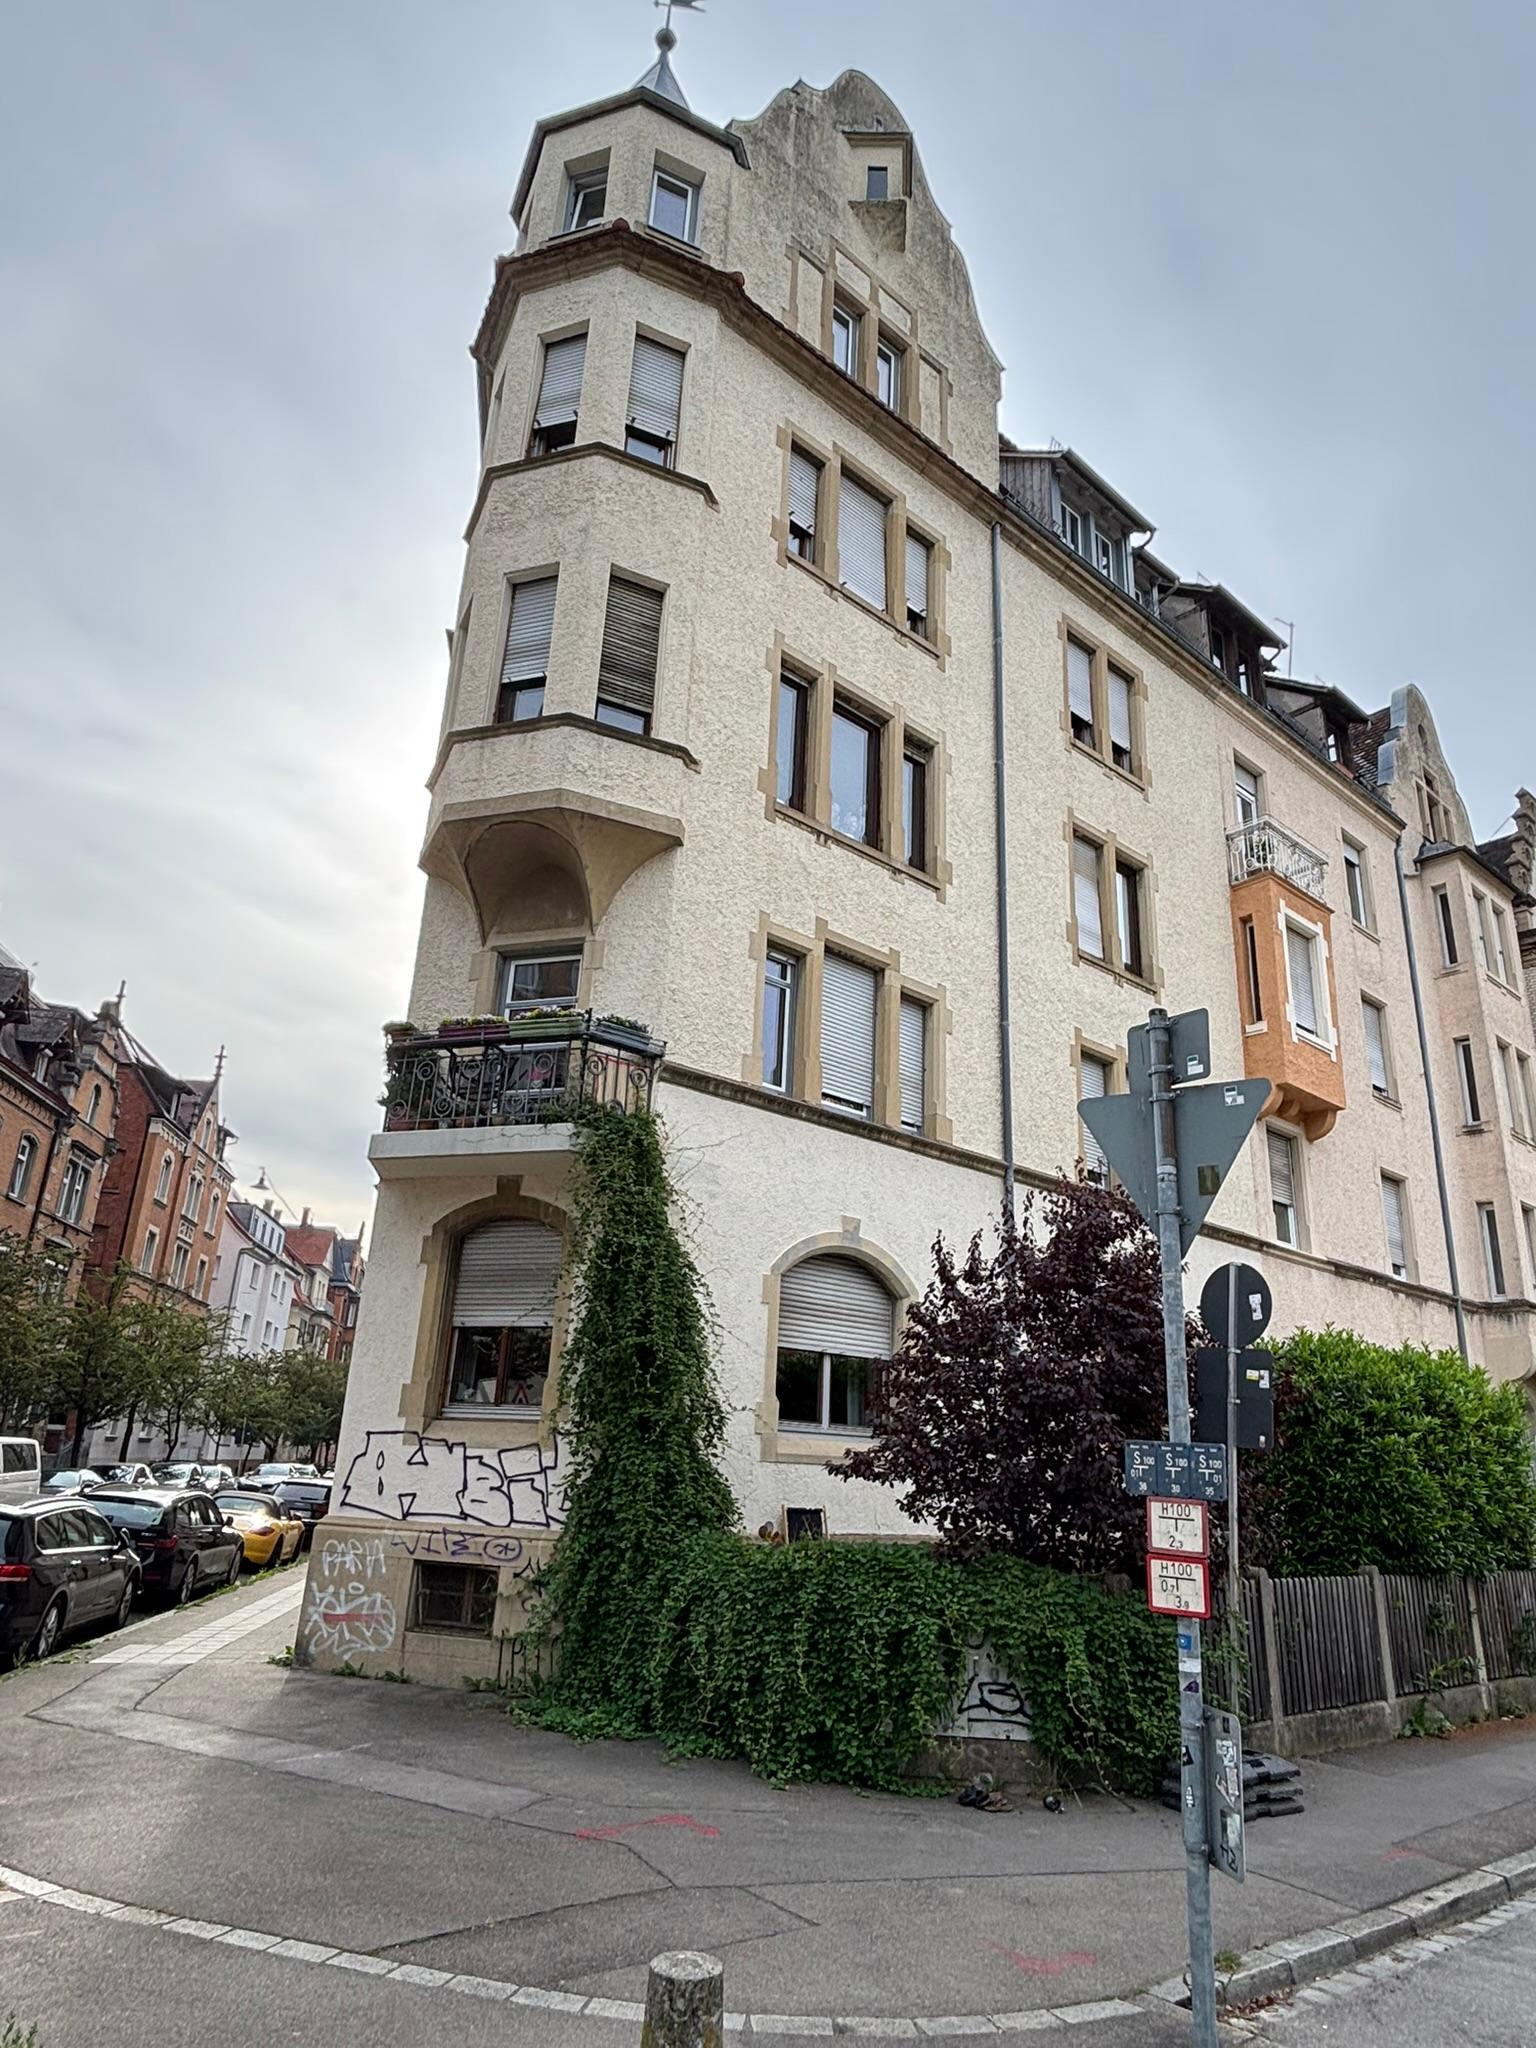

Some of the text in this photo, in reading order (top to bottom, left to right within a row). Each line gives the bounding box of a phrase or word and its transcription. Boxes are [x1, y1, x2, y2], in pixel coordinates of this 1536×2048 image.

[1133, 1451, 1155, 1465] S 100
[1165, 1452, 1188, 1467] S 100
[1199, 1454, 1222, 1469] S 100
